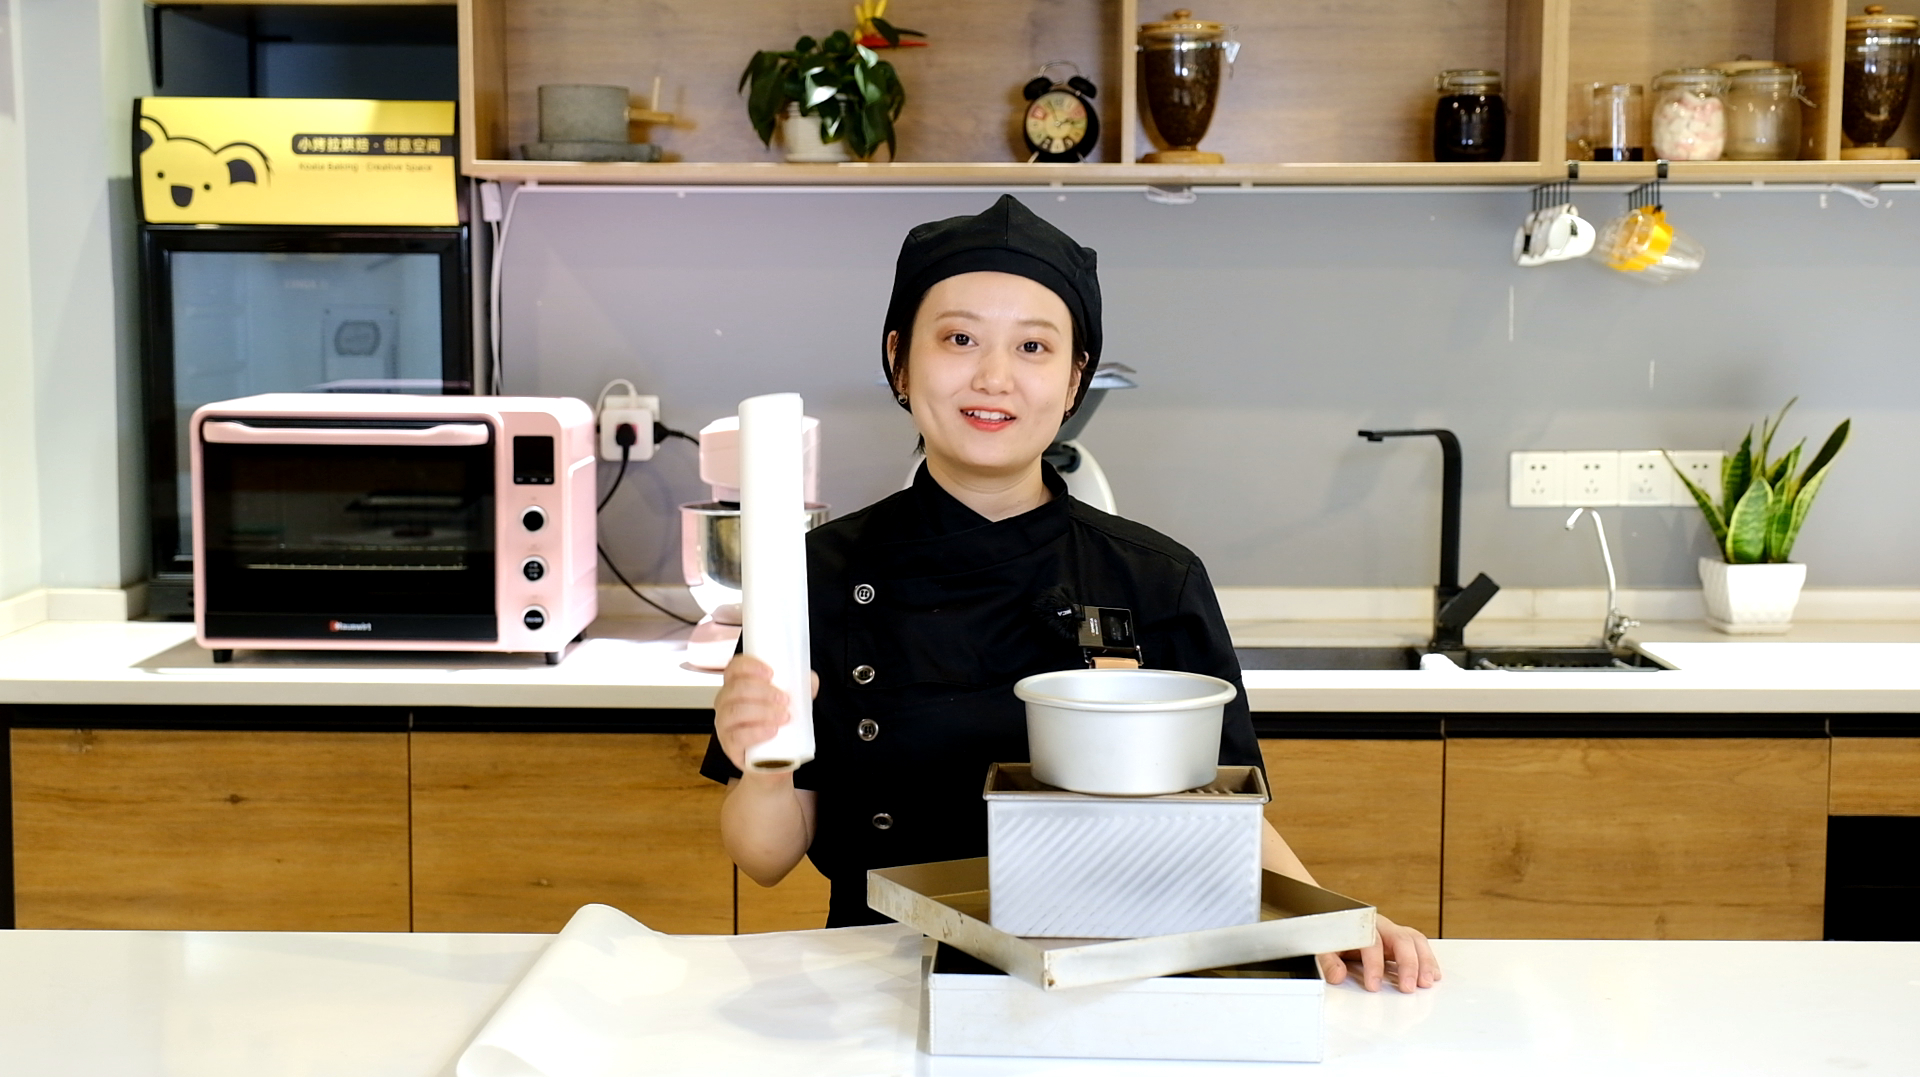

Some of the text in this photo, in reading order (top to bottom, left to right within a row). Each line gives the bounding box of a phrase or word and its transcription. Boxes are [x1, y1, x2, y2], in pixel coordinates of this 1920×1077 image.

[328, 163, 359, 173] Baking
[366, 163, 403, 171] Creative
[405, 163, 433, 172] Space
